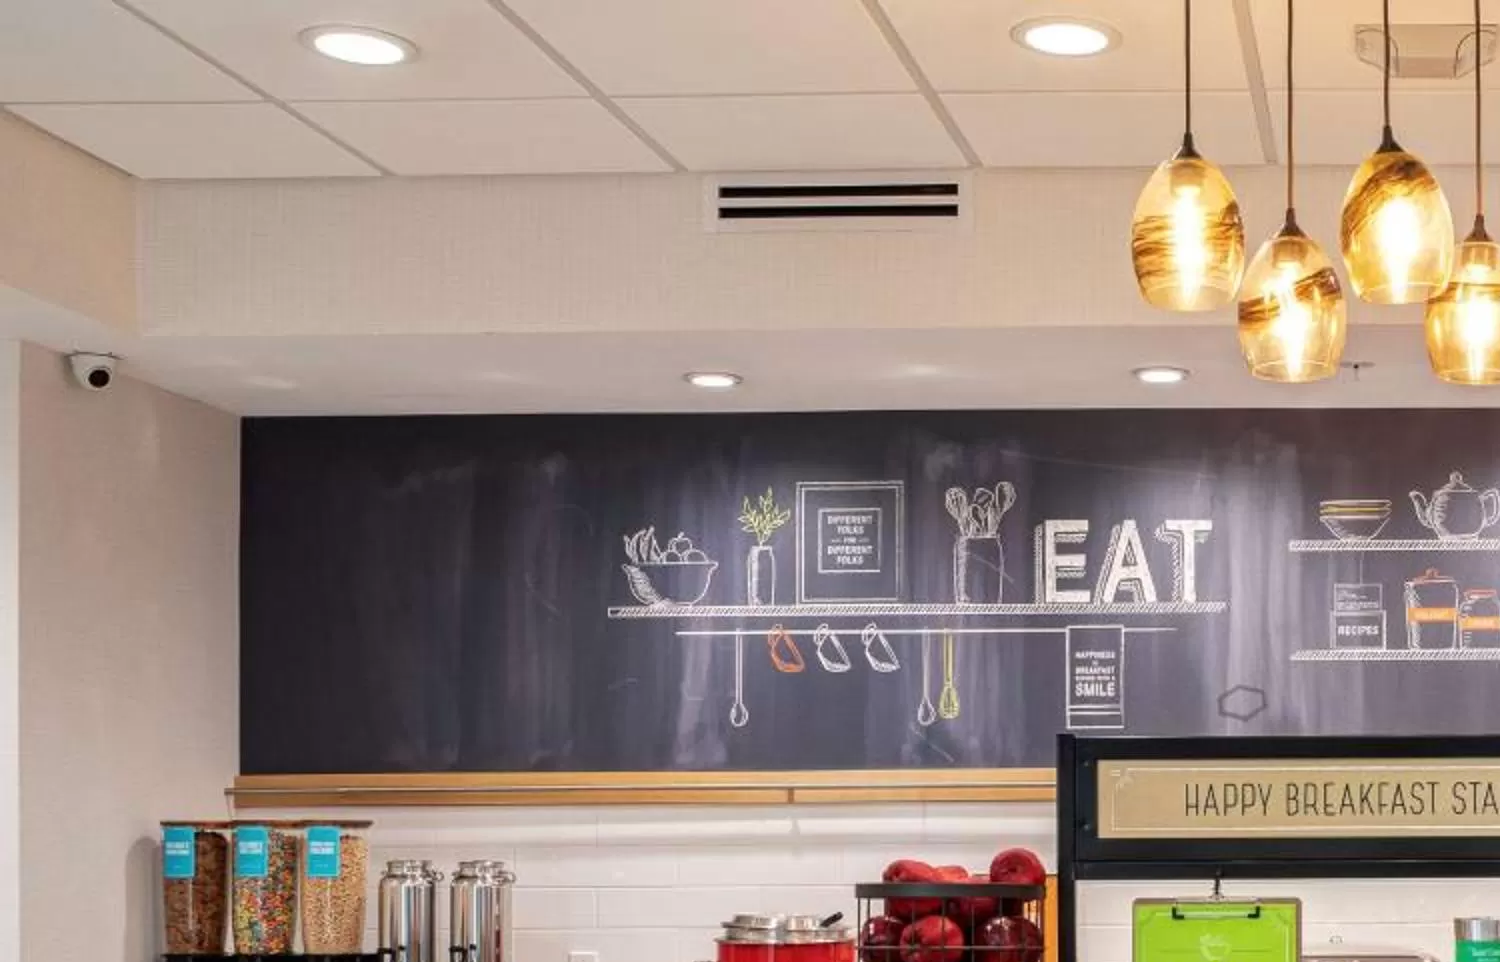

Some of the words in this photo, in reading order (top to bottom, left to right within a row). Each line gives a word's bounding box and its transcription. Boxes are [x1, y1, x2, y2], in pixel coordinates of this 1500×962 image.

[1035, 519, 1212, 603] EAT
[1075, 682, 1116, 697] SMILE
[1184, 782, 1273, 817] HAPPY
[1285, 780, 1440, 817] BREAKFAST
